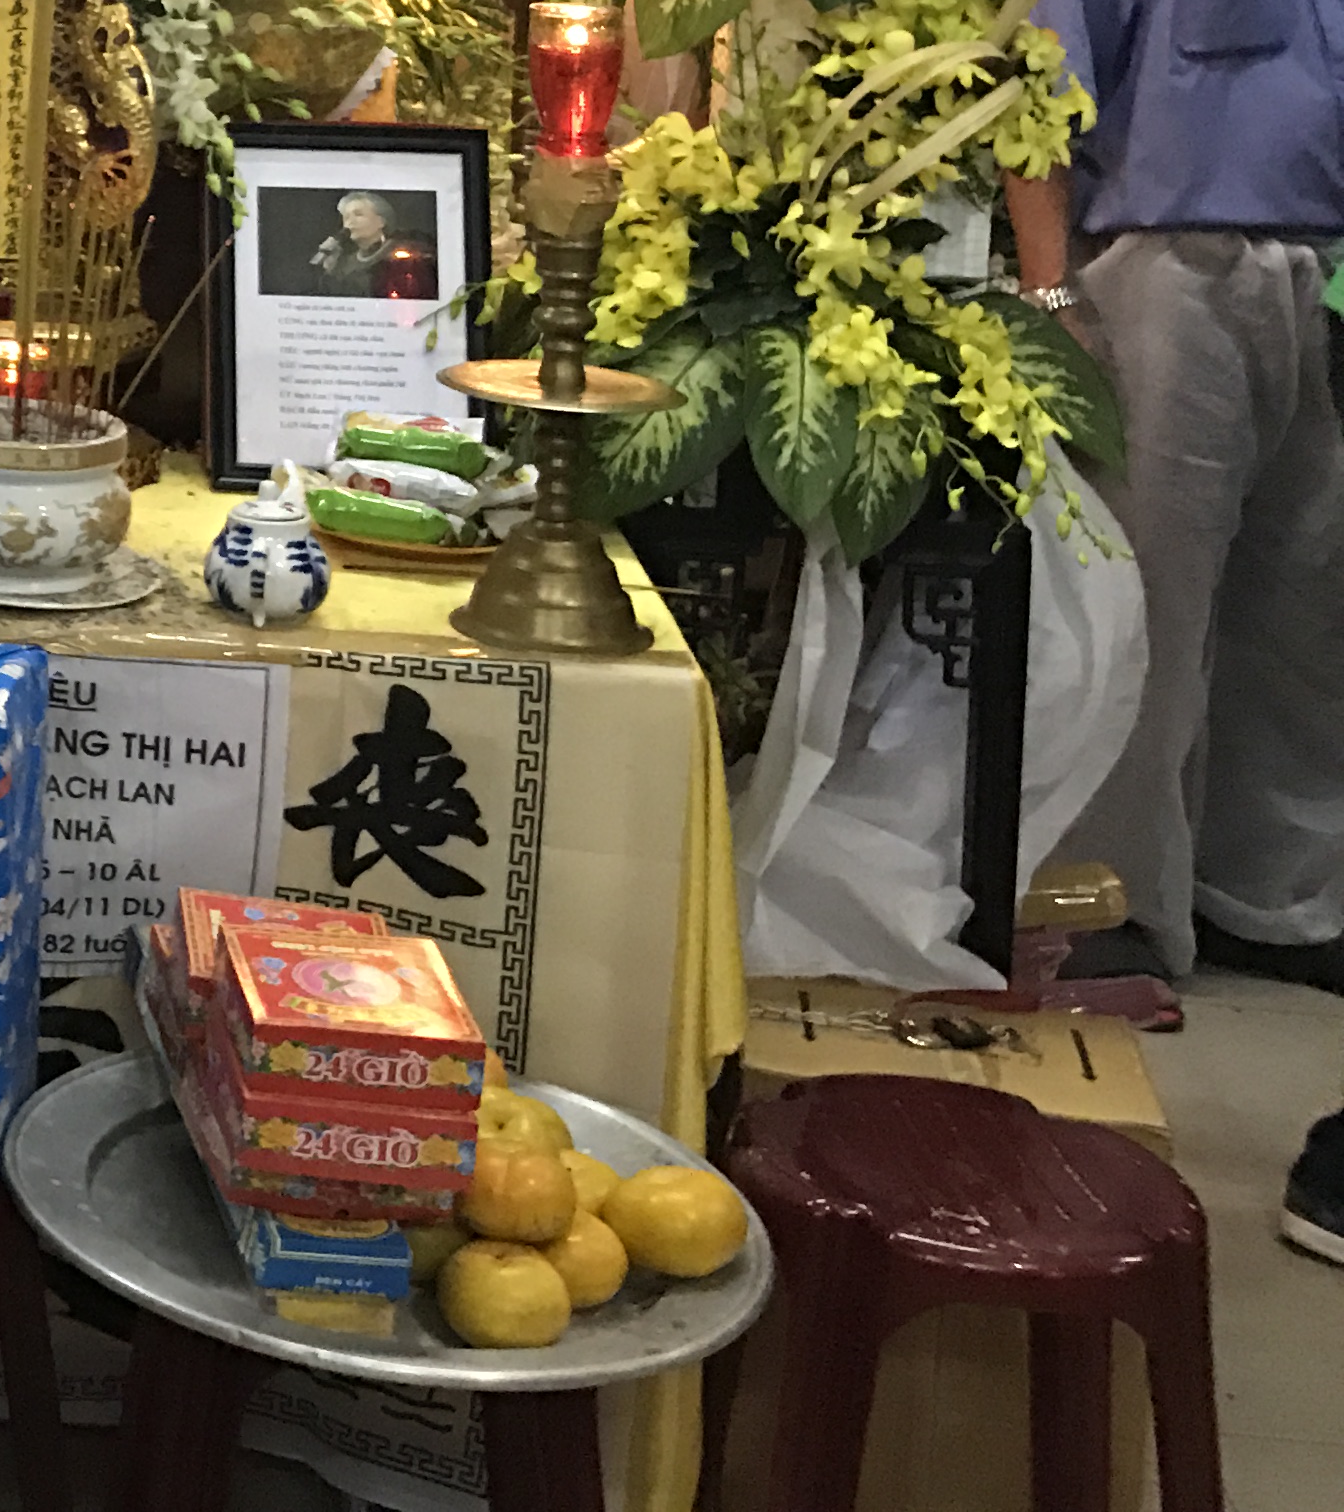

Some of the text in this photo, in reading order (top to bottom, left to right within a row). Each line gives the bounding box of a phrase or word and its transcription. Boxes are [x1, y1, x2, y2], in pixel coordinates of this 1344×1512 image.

[53, 727, 246, 768] NG THỊ HAI
[45, 774, 175, 805] ẠCH LAN
[88, 861, 118, 881] 10
[125, 859, 161, 881] ÂL
[122, 896, 165, 918] DL)
[42, 933, 75, 954] 82
[302, 1050, 430, 1088] 24 GIỜ
[292, 1128, 422, 1167] 24 GIỜ
